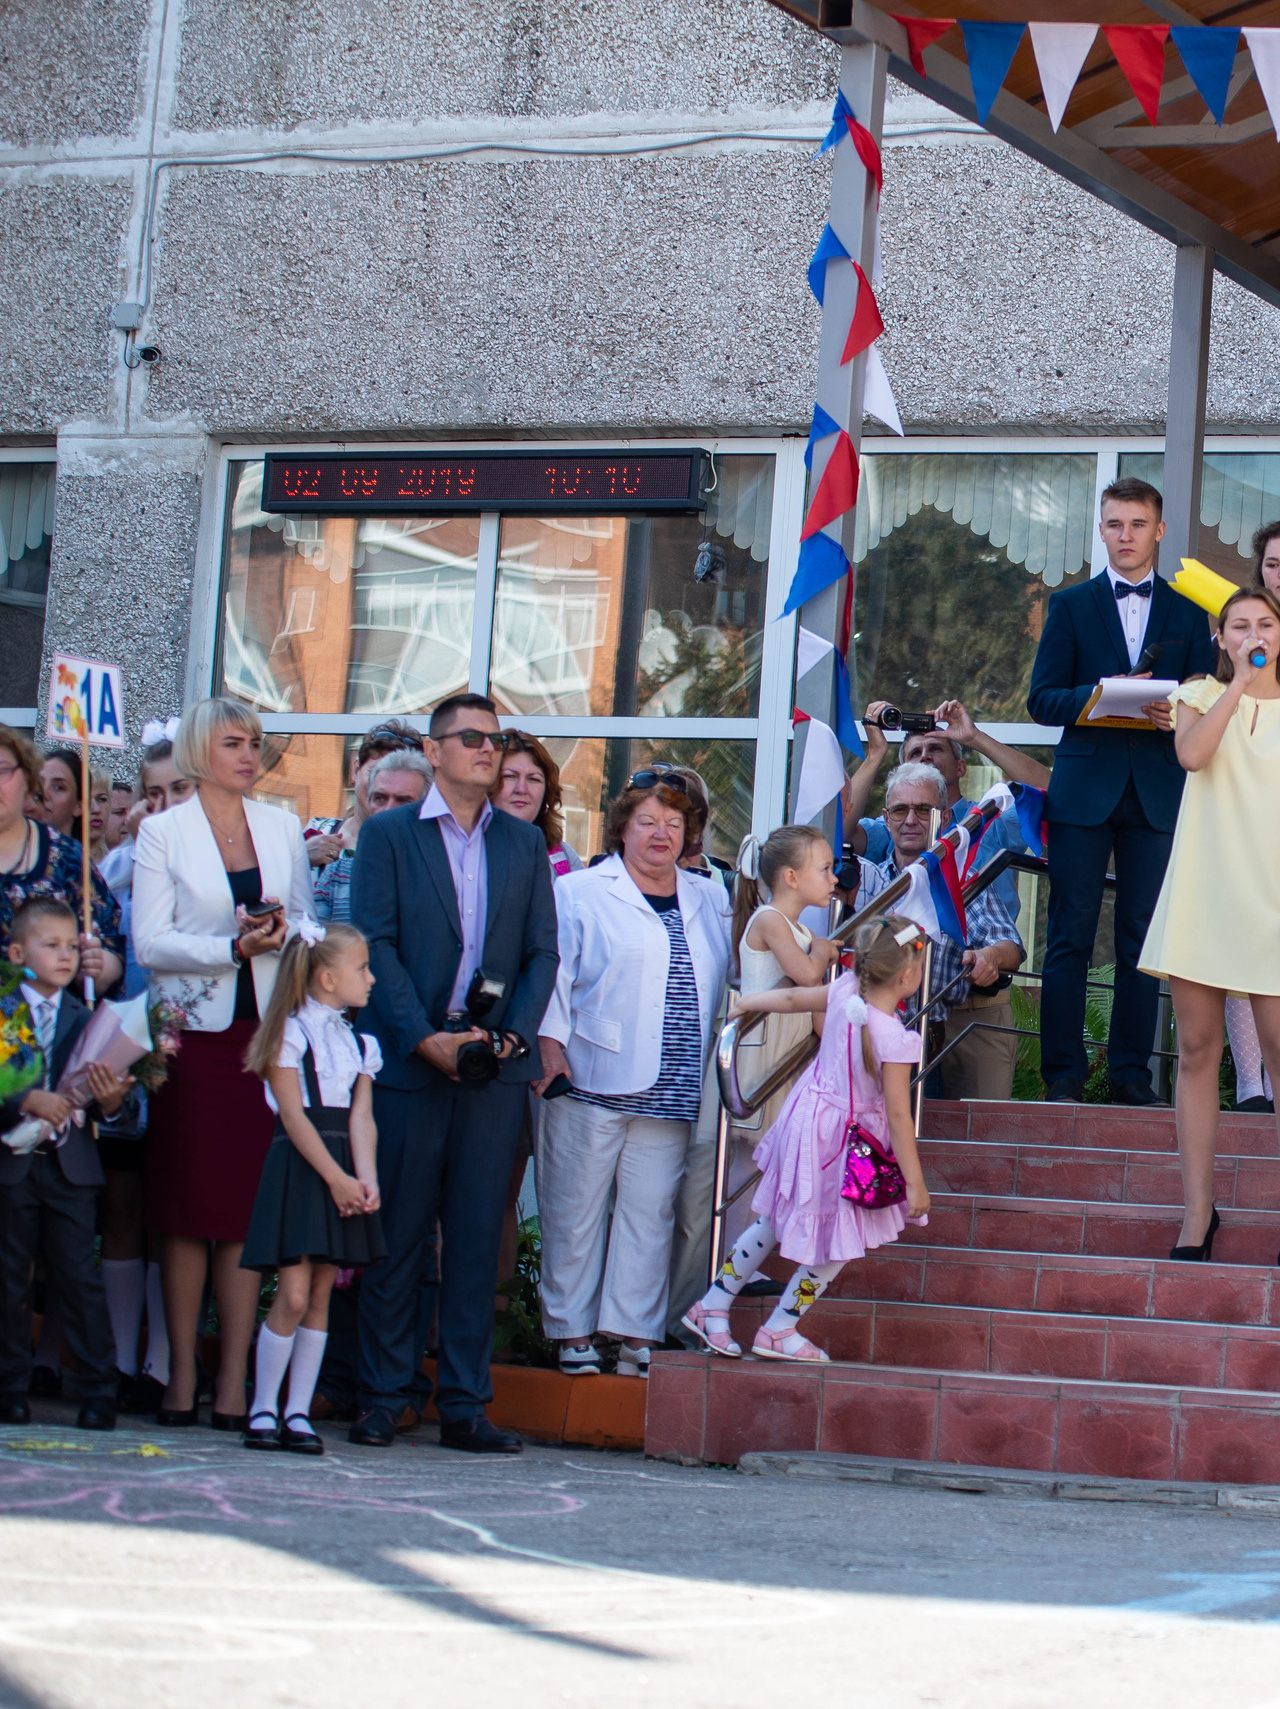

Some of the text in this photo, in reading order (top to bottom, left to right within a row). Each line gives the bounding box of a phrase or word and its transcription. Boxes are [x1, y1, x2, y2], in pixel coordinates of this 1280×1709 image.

[284, 468, 321, 497] 02
[341, 468, 379, 497] 09
[398, 468, 476, 498] 2019
[80, 668, 121, 737] 1А
